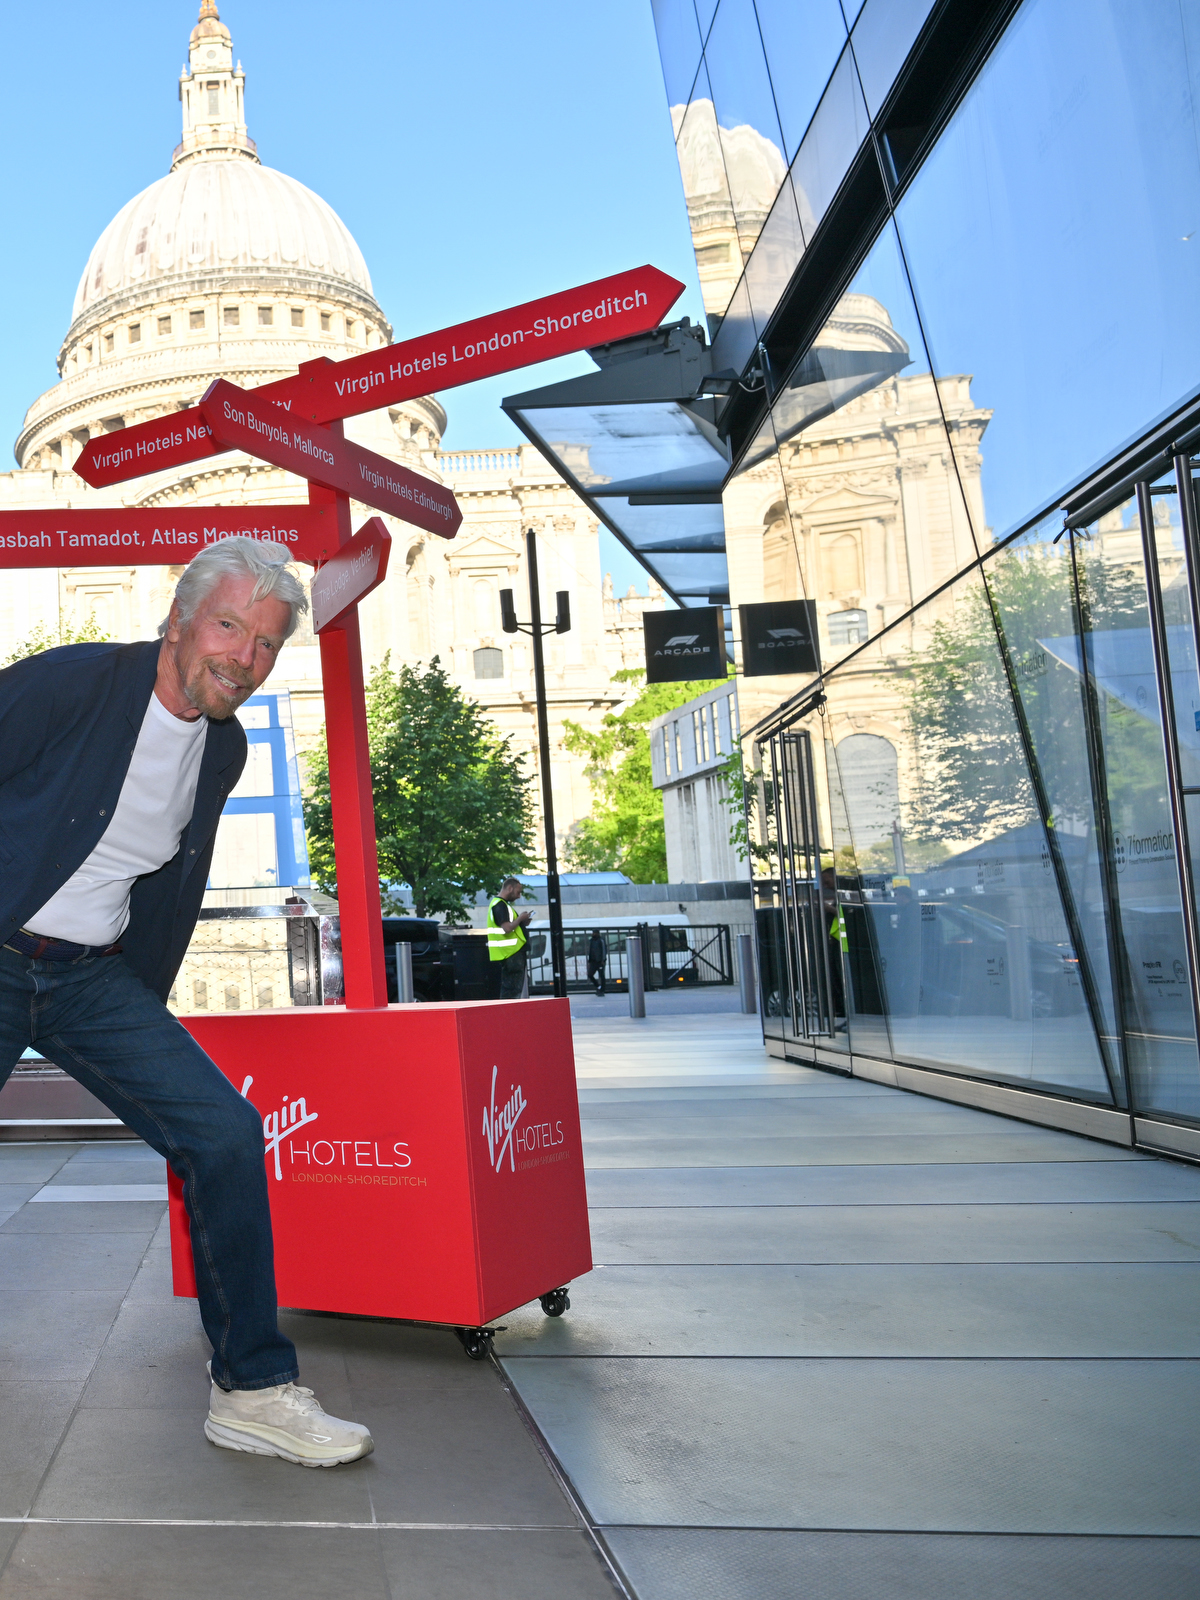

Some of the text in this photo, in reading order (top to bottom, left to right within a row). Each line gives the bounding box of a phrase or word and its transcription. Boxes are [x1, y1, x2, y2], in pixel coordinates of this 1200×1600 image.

[334, 289, 648, 396] Virgin Hotels London-Shoreditch
[223, 401, 335, 465] Son Bunyola, Mallorca
[92, 447, 133, 470] Virgin
[136, 432, 183, 457] Hotels
[359, 463, 453, 521] Virgin Hotels Edinburgh
[56, 529, 146, 548] Tamadot,
[151, 528, 199, 546] Atlas
[319, 586, 331, 606] The
[350, 544, 374, 576] Verbier
[653, 646, 711, 656] ARCADE
[482, 1065, 528, 1173] Virgin
[516, 1120, 564, 1153] HOTELS
[289, 1140, 412, 1168] HOTELS
[518, 1150, 570, 1171] LONDON-SHOREDITCH
[291, 1172, 428, 1187] LONDON-SHOREDITCH
